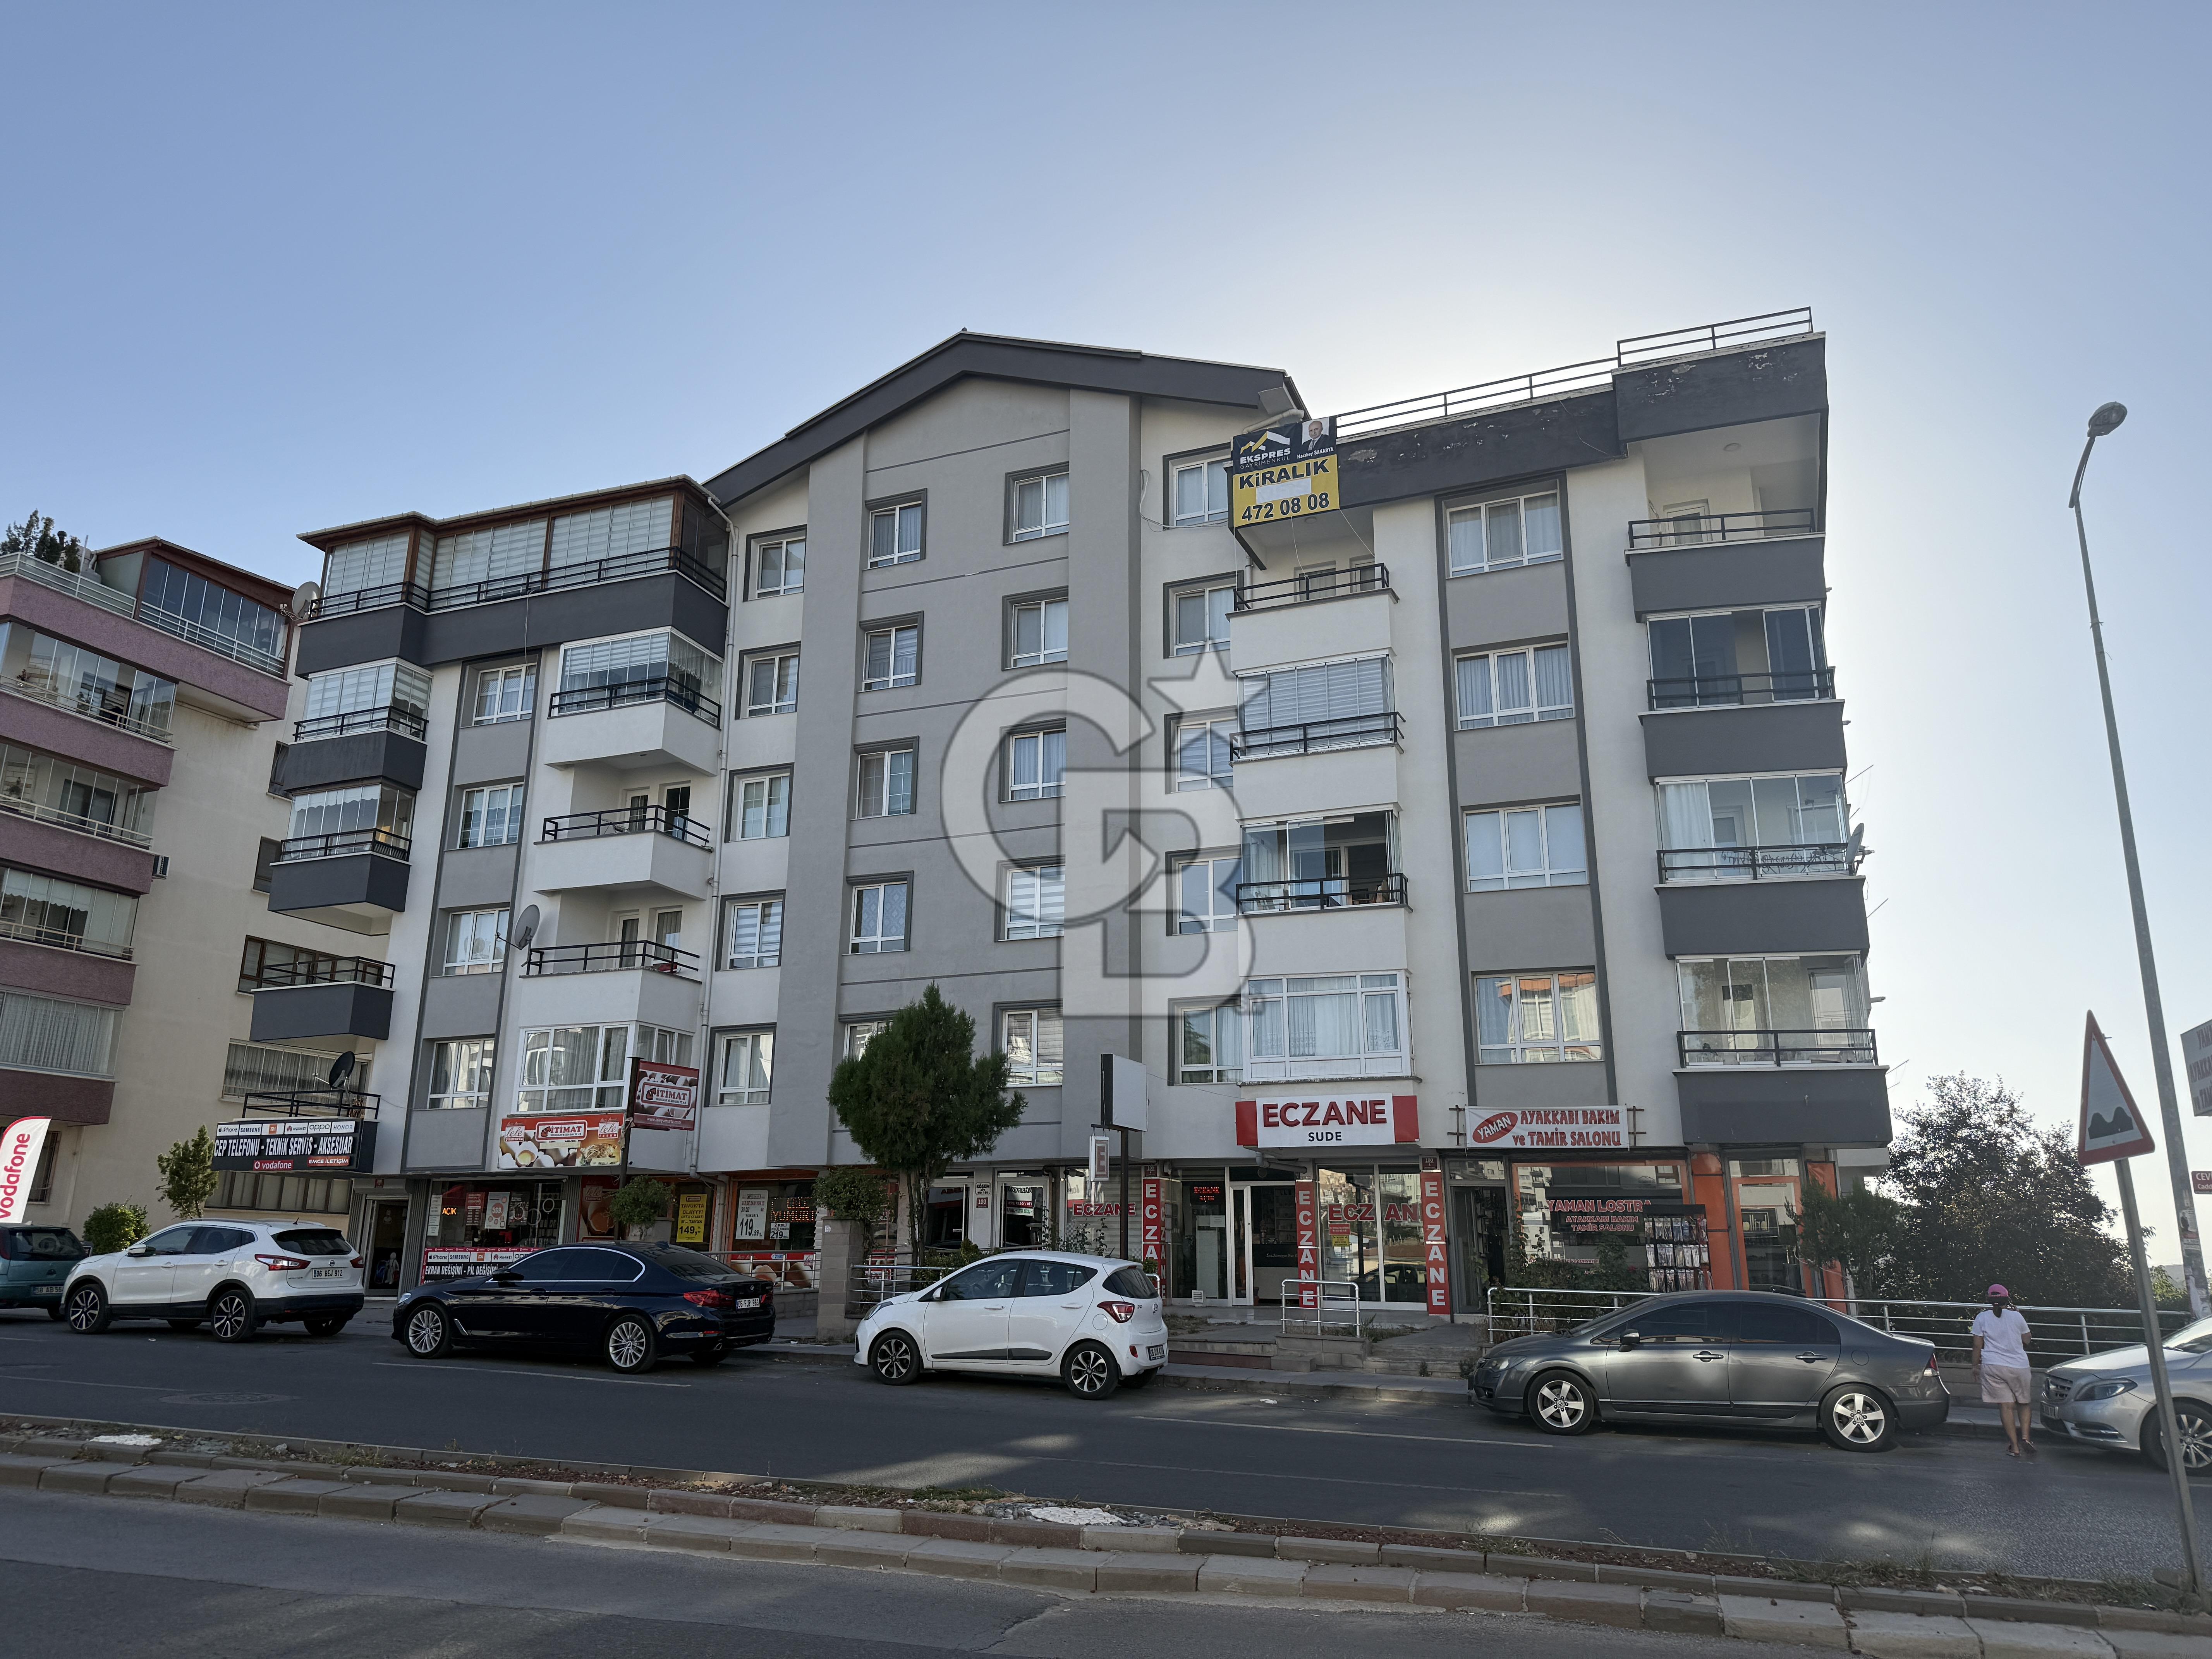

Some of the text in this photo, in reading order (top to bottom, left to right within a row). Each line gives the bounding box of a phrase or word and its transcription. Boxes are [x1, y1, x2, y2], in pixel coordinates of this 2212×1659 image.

[1240, 448, 1291, 464] EKSPRES
[1314, 447, 1334, 455] SAKARYA
[1242, 492, 1329, 521] 472 08 08
[657, 1088, 687, 1100] İTİMAT
[1263, 1100, 1387, 1127] ECZANE
[1520, 1110, 1620, 1125] AYAKKABI BAKIM
[1477, 1115, 1512, 1140] YAMAN
[1308, 1132, 1342, 1142] SUDE
[1512, 1127, 1622, 1146] ve TAMİR SALONU
[214, 1139, 227, 1157] CEP
[228, 1138, 260, 1156] TELEFONU
[318, 1136, 353, 1154] AKSESUAR
[262, 1161, 292, 1169] vodafone
[1097, 1146, 1106, 1172] E
[0, 1133, 30, 1219] vodafone
[1073, 1202, 1136, 1216] ECZANE
[1546, 1199, 1594, 1212] YAMAN
[773, 1211, 816, 1221] YUMURT
[1145, 1184, 1158, 1259] ECZA
[1571, 1223, 1598, 1231] TAMİR
[1298, 1190, 1315, 1305] ECZANE
[1425, 1182, 1445, 1306] ECZANE
[425, 1266, 440, 1275] EKRAN
[441, 1264, 463, 1277] DEĞİŞİMİ
